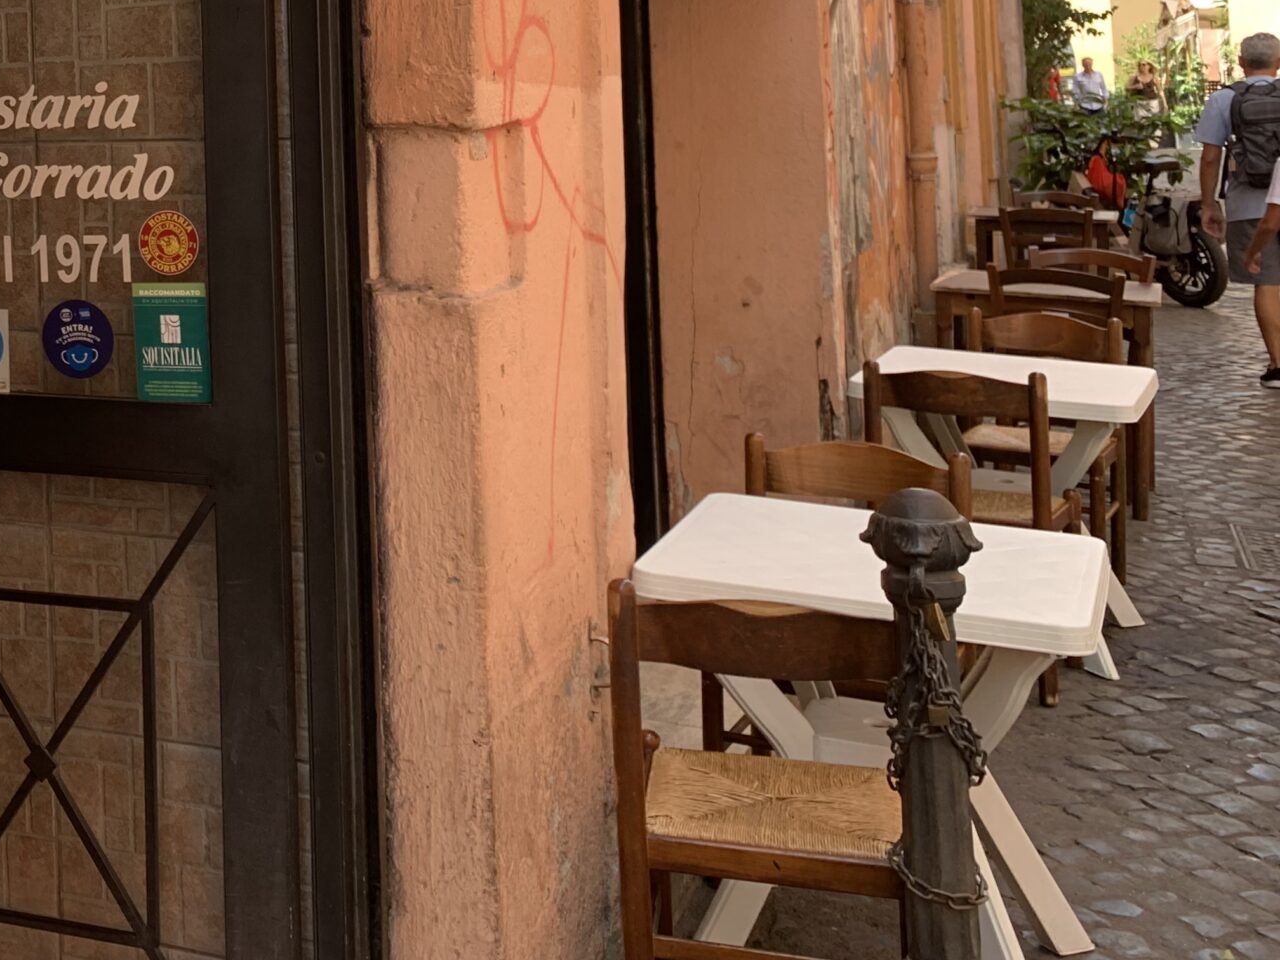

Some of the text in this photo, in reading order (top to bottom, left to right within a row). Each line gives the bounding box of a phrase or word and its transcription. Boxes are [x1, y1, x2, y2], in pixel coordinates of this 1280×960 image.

[147, 213, 193, 234] HOSTARIA
[31, 234, 132, 283] 1971
[151, 252, 194, 273] CORRADO
[142, 346, 203, 368] SQUISITALIA
